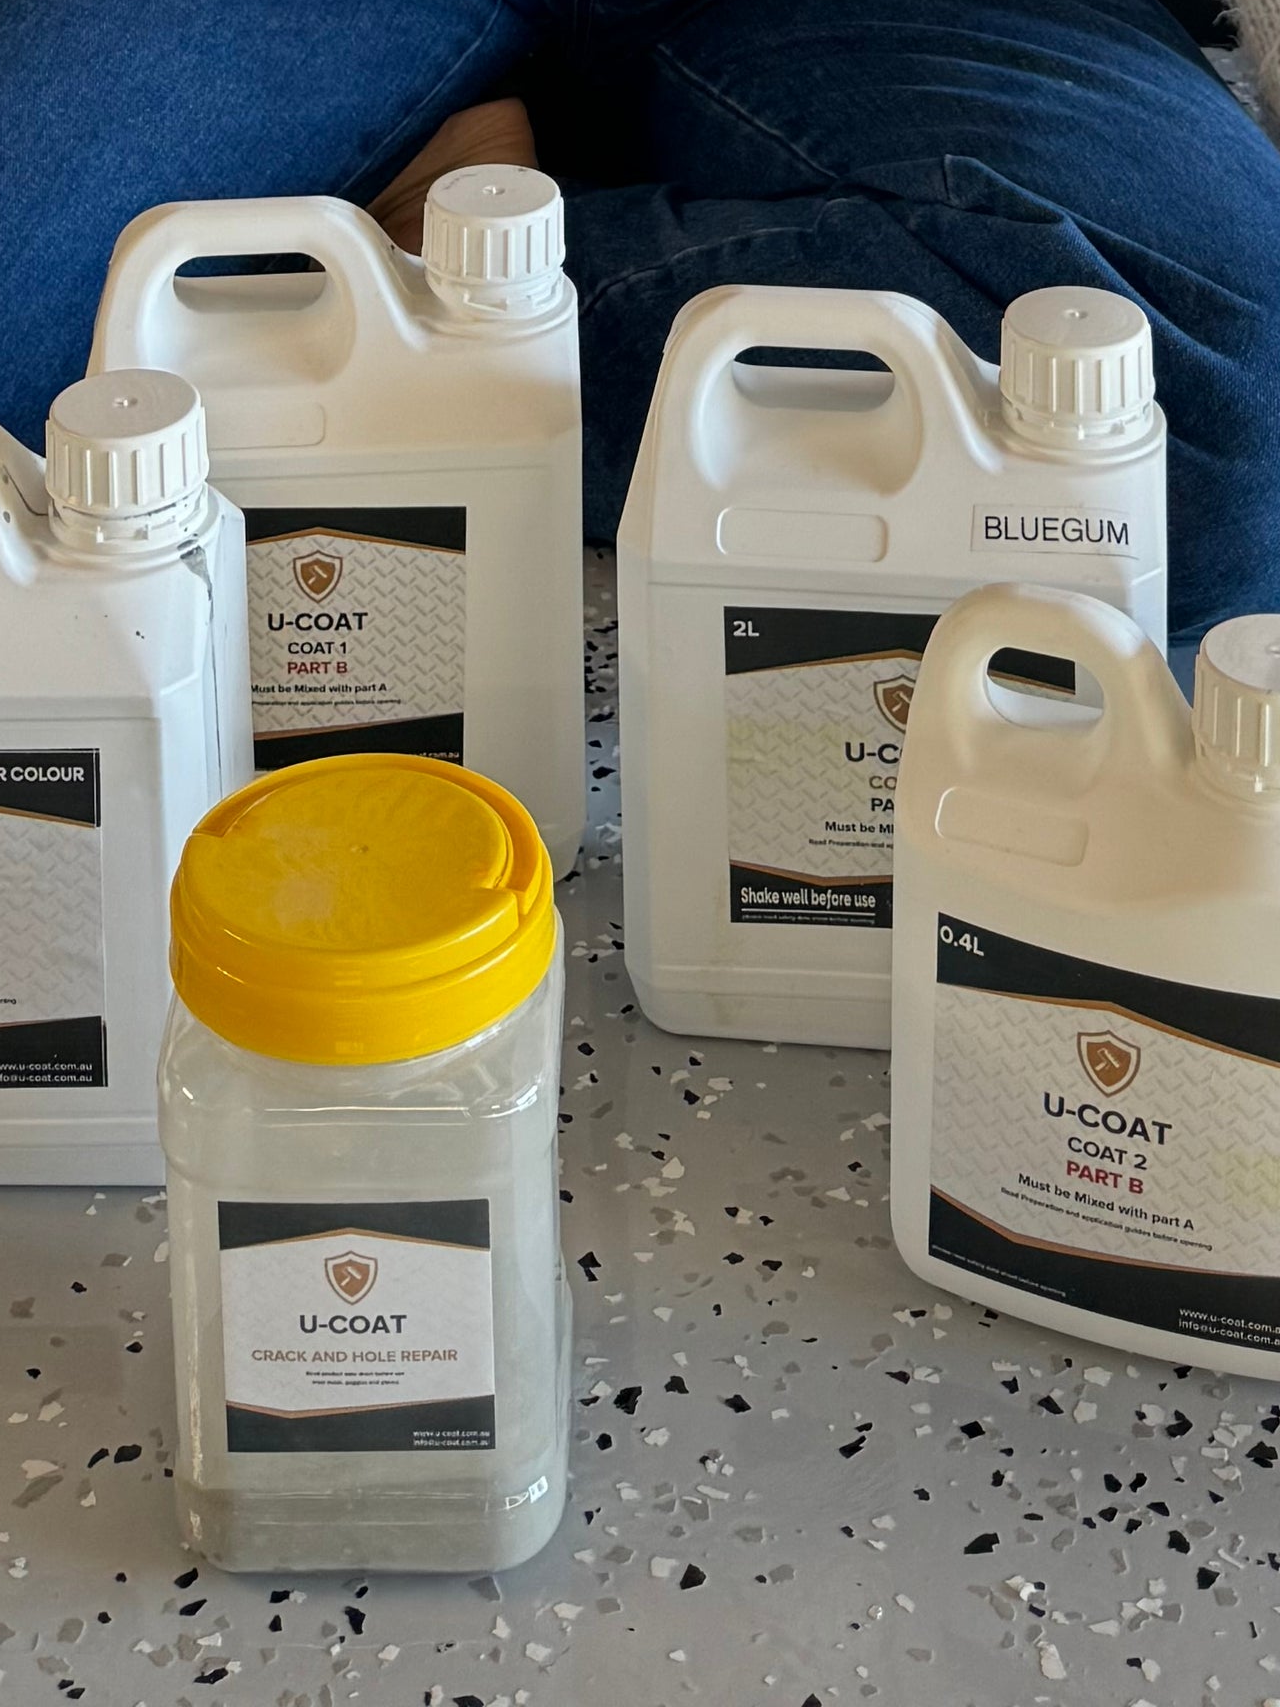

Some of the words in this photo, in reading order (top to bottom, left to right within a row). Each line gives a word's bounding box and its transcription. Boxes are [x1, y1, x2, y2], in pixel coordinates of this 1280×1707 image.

[984, 515, 1130, 546] BLUEGUM
[268, 612, 369, 631] U-COAT
[732, 620, 760, 637] 2L
[287, 642, 335, 654] COAT
[339, 642, 347, 654] 1
[287, 662, 332, 674] PART
[336, 662, 348, 674] B
[278, 684, 292, 693] be
[294, 684, 326, 693] Mixed
[328, 683, 352, 693] with
[354, 684, 377, 694] part
[378, 683, 387, 692] A
[845, 741, 902, 764] U-C
[9, 766, 85, 782] COLOUR
[869, 775, 897, 790] CO
[871, 797, 894, 812] PA
[825, 821, 857, 832] Must
[860, 822, 876, 833] be
[741, 886, 780, 905] Shake
[781, 888, 808, 906] well
[811, 889, 852, 909] before
[854, 893, 876, 908] use
[939, 925, 985, 958] 0.4L
[1043, 1091, 1173, 1145] U-COAT
[1067, 1137, 1128, 1165] COAT
[1133, 1154, 1148, 1170] 2
[1066, 1160, 1123, 1189] PART
[1128, 1177, 1144, 1194] B
[1018, 1173, 1051, 1193] Must
[1054, 1184, 1071, 1199] be
[1074, 1191, 1115, 1212] Mixed
[1118, 1204, 1148, 1220] with
[1151, 1212, 1180, 1227] part
[1183, 1219, 1195, 1231] A
[299, 1314, 407, 1335] U-COAT
[251, 1349, 307, 1362] CRACK
[312, 1350, 348, 1363] AND
[352, 1350, 396, 1363] HOLE
[401, 1349, 459, 1362] REPAIR
